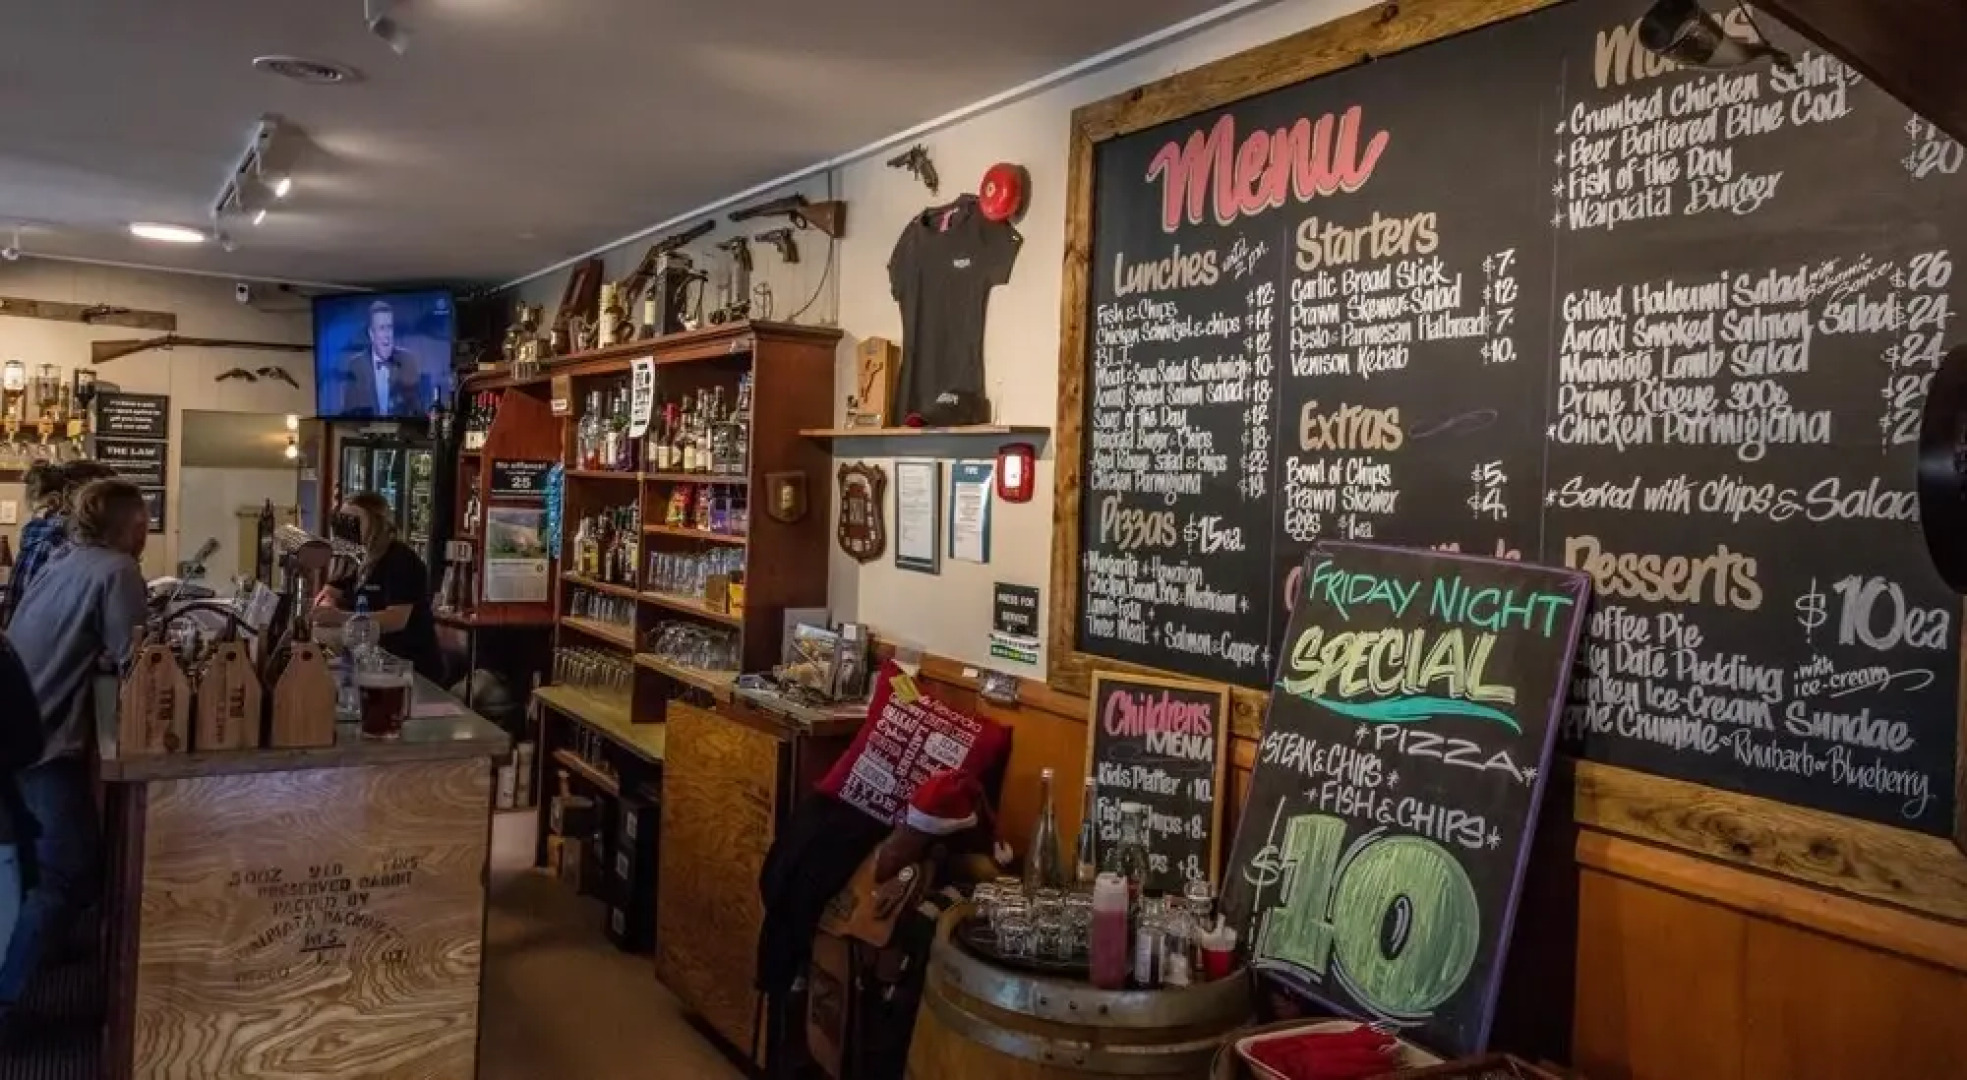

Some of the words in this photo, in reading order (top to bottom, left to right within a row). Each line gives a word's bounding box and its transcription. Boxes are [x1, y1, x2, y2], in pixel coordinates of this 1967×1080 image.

[1570, 86, 1662, 136] Crumbed
[1669, 72, 1760, 117] Chicken
[1570, 135, 1619, 169] Beer
[1621, 115, 1717, 156] Battered
[1725, 101, 1785, 139] Blue
[1145, 104, 1391, 233] Menu
[1569, 165, 1611, 199] Fish
[1687, 148, 1734, 182] Day
[1570, 188, 1672, 231] Waipiata
[1683, 170, 1783, 215] Burger
[1296, 211, 1439, 271] Starters
[1115, 244, 1219, 297] Lunches
[1291, 271, 1337, 302] Garlic
[1342, 264, 1391, 295] Bread
[1396, 255, 1452, 289] Stick
[1563, 286, 1627, 322] Grilled
[1732, 266, 1809, 306] Salad
[1290, 302, 1340, 327] Prawn
[1411, 273, 1463, 314] Salad
[1632, 313, 1714, 348] Smoked
[1720, 305, 1814, 345] Salmon
[1819, 292, 1896, 334] Salad
[1290, 328, 1330, 351] Pesto
[1341, 321, 1412, 347] Parmesan
[1663, 346, 1724, 379] Lamb
[1730, 336, 1809, 374] Salad
[1290, 350, 1350, 377] Venison
[1357, 343, 1409, 381] Kebab
[1558, 384, 1627, 414] Prime
[107, 446, 127, 455] THE
[130, 447, 155, 456] LAW
[1300, 400, 1403, 451] Extras
[1556, 411, 1653, 452] Chicken
[511, 476, 531, 489] 25
[1284, 482, 1336, 514] Prawn
[1342, 485, 1400, 514] Skewer
[1286, 456, 1325, 484] Bowl
[1347, 456, 1392, 490] Chips
[1100, 492, 1177, 549] Pizzas
[1560, 474, 1642, 511] Served
[1644, 474, 1698, 515] with
[1700, 474, 1775, 524] Chips
[1284, 509, 1321, 541] Eggs
[1565, 535, 1764, 611] Desserts
[1021, 597, 1036, 607] FOR
[1310, 560, 1421, 622] FRIDAY
[1430, 575, 1574, 638] NIGHT
[1656, 612, 1704, 649] Pie
[1284, 625, 1516, 705] SPECIAL
[1615, 641, 1669, 678] Date
[1671, 648, 1785, 703] Pudding
[1104, 690, 1212, 736] Childrens
[1786, 702, 1912, 752] Sundae
[1146, 729, 1213, 762] MENU
[1375, 724, 1524, 782] PIZZA
[1618, 705, 1719, 753] Crumble
[1733, 729, 1812, 777] Rhubarb
[1826, 742, 1930, 819] Blueberry
[1098, 762, 1131, 787] Kids
[1131, 766, 1181, 795] Platter
[1319, 782, 1376, 818] FISH
[1397, 797, 1486, 849] CHIPS
